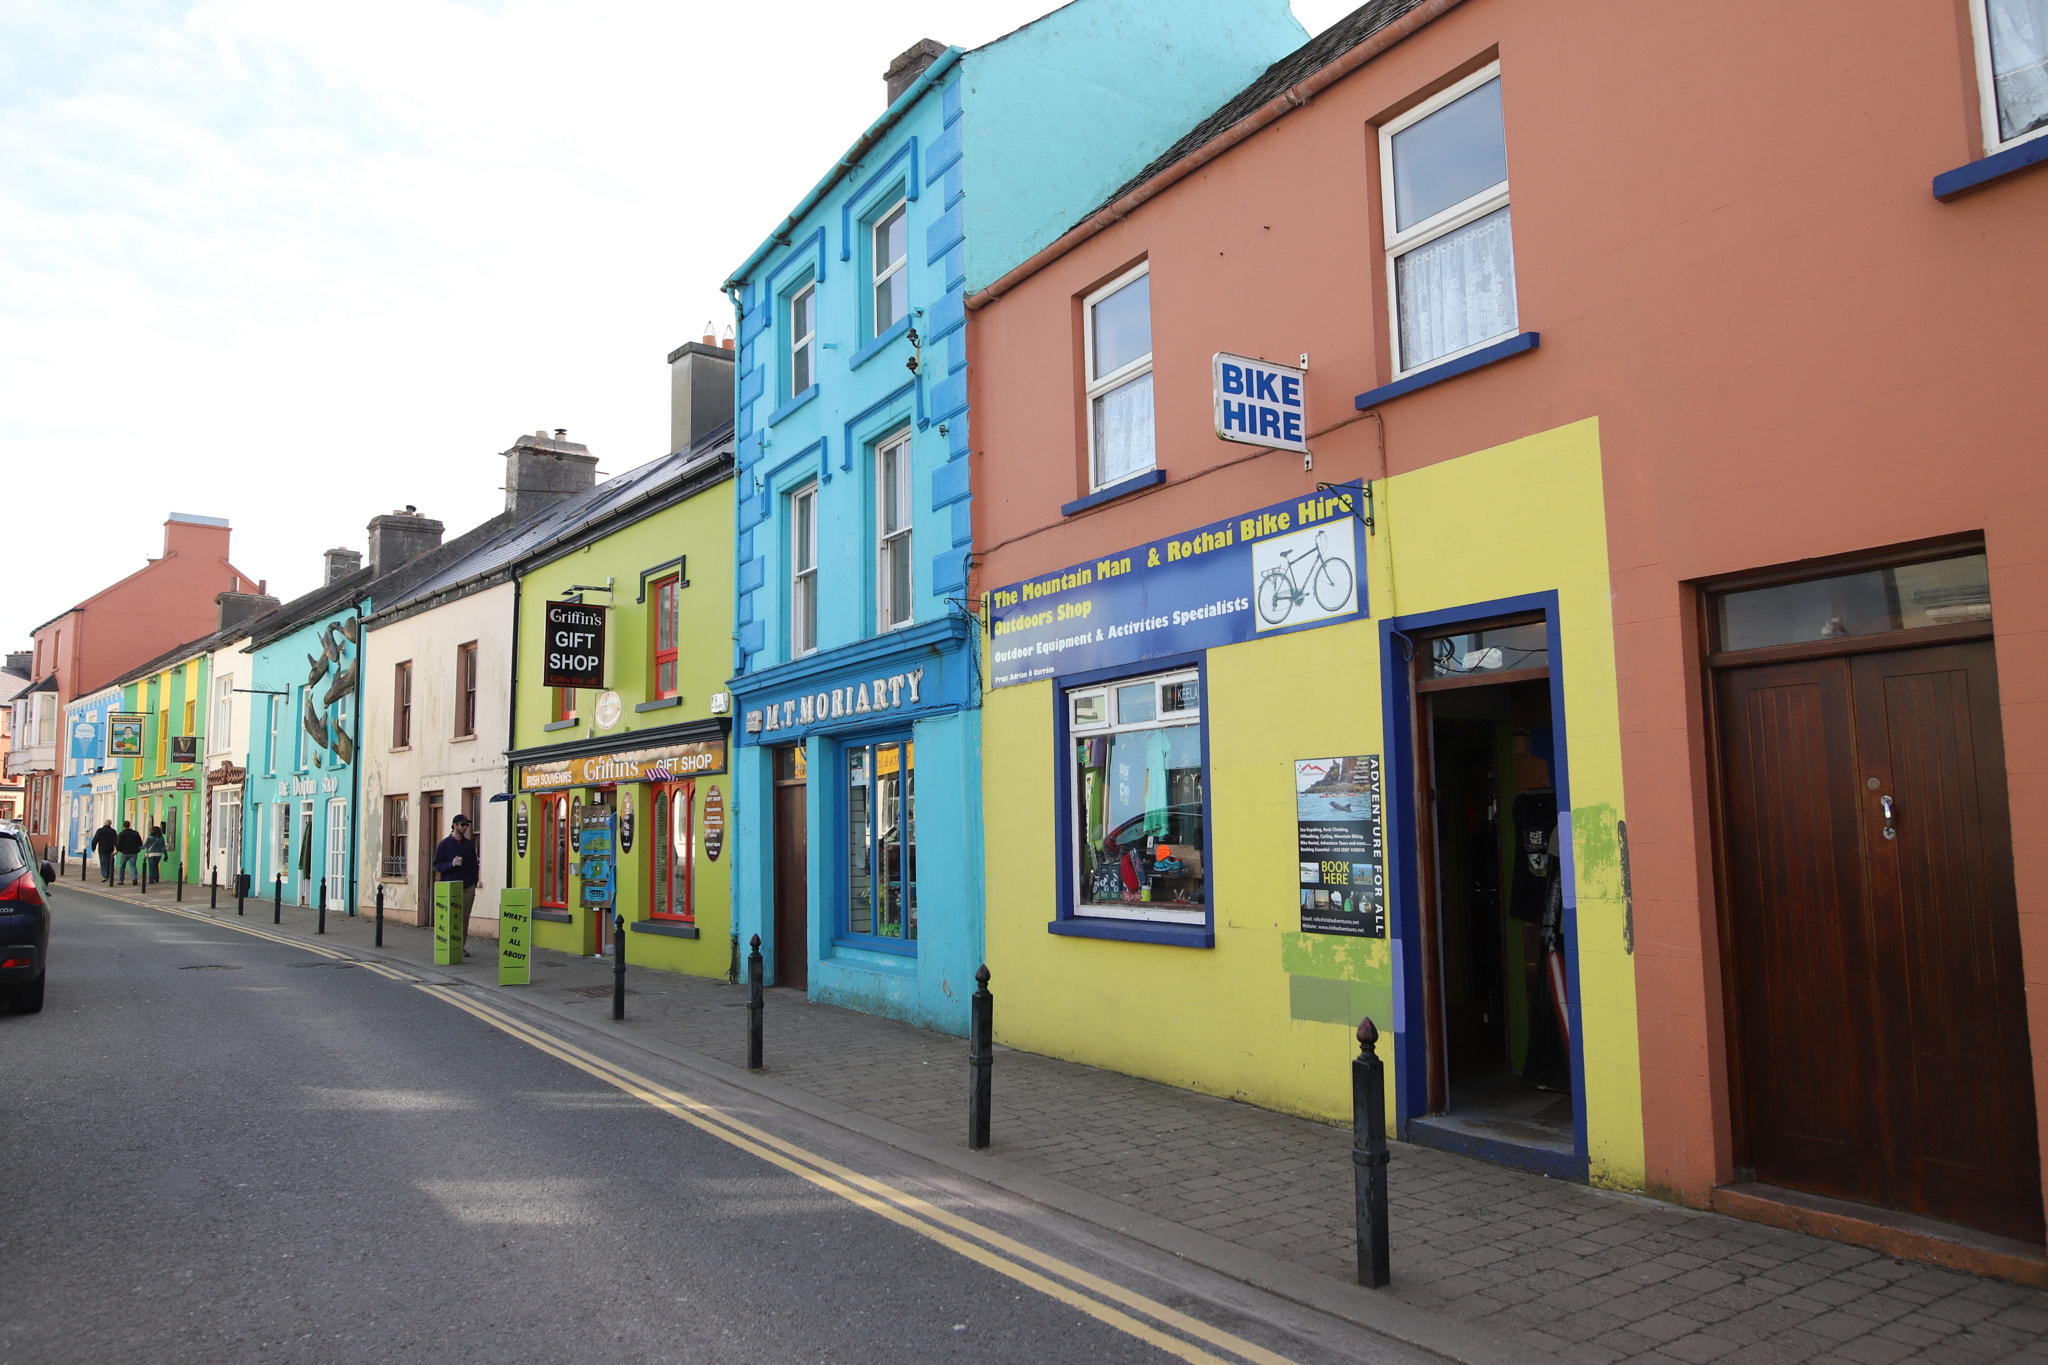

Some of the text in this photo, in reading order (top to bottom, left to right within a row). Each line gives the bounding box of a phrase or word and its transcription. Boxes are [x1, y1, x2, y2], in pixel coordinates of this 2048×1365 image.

[1222, 363, 1301, 407] BIKE
[1223, 399, 1302, 443] HIRE
[994, 493, 1353, 609] The Mountain Man & Rothaí Bike Hire
[550, 608, 602, 627] Griffin's
[994, 600, 1092, 636] Outdoors Shop
[994, 597, 1249, 663] Outdoor Equipment & Activities Specialists
[555, 631, 595, 649] GIFT
[549, 653, 599, 671] SHOP
[1009, 672, 1027, 681] Adrian
[1177, 686, 1198, 702] KEELA
[583, 757, 639, 781] Griffin's
[655, 753, 712, 772] GIFT SHOP
[526, 771, 572, 787] IRISH SOUVENIRS
[1370, 759, 1384, 933] ADVENTURE FOR ALL
[1321, 861, 1350, 873] BOOK
[1323, 873, 1349, 885] HERE
[503, 911, 528, 923] WHAT'S
[508, 938, 521, 947] ALL
[503, 949, 527, 961] ABOUT
